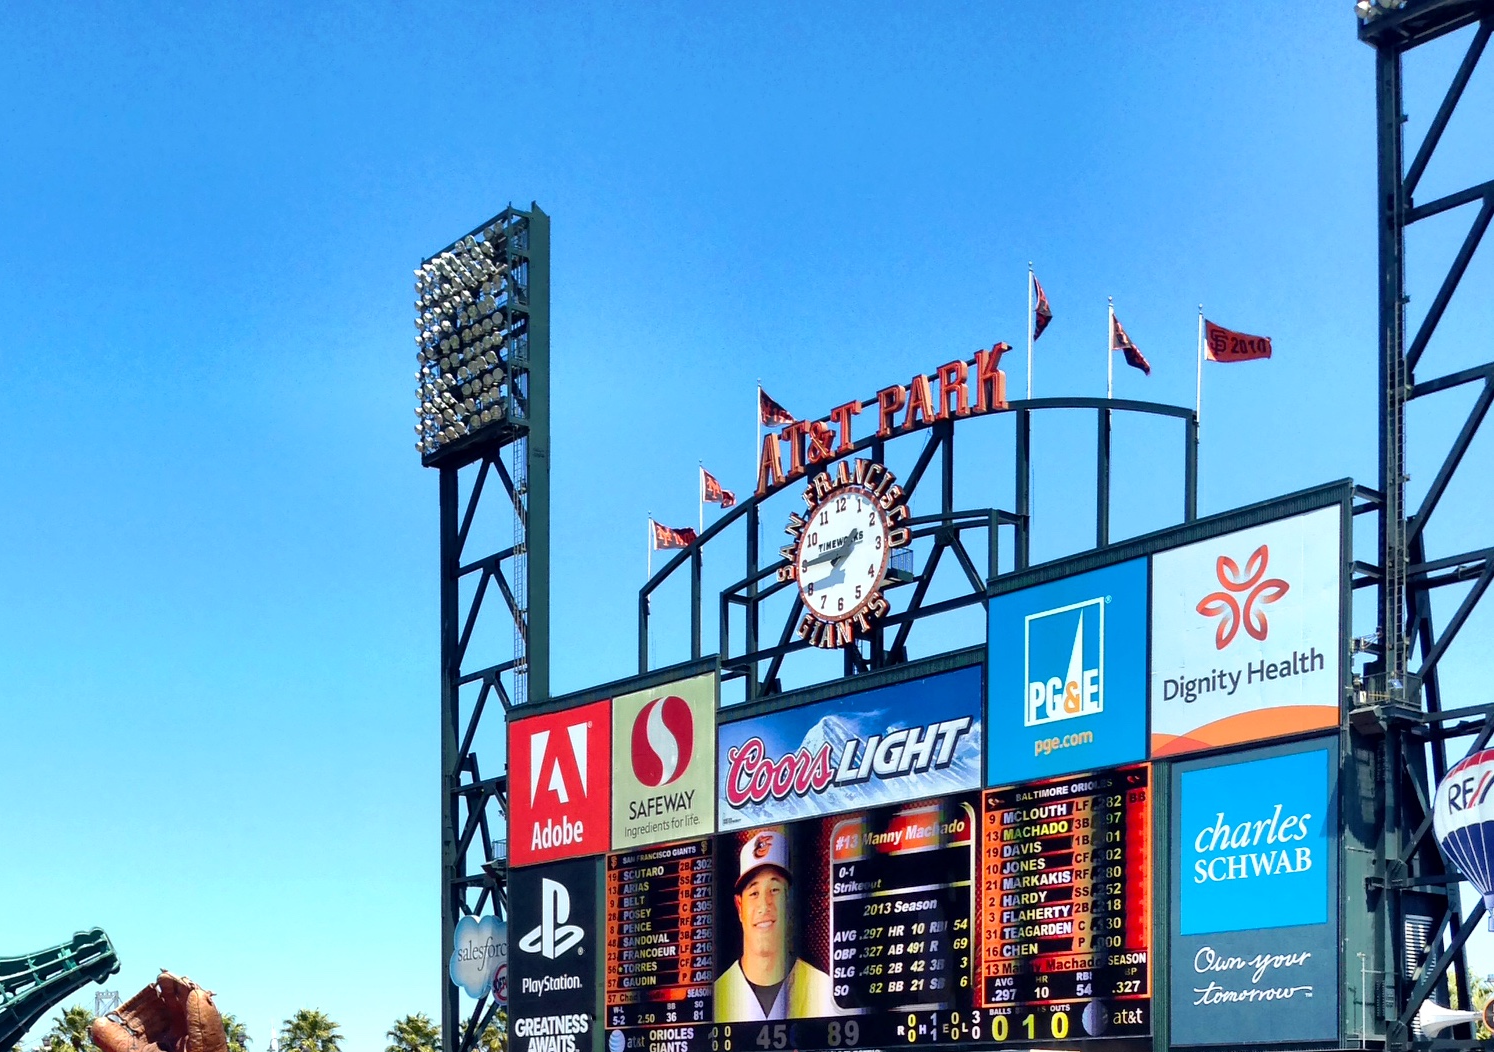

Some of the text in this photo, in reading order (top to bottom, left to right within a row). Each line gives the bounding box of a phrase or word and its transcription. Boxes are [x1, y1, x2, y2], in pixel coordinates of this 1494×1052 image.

[1230, 337, 1266, 355] 2010
[754, 341, 1012, 497] AT&T PARK
[835, 498, 847, 514] 12
[775, 457, 913, 583] SAN FRANCISCO
[819, 511, 829, 526] 11
[807, 532, 818, 548] 10
[817, 530, 865, 553] TIMEWOKS
[796, 591, 890, 650] GIANTS
[1163, 647, 1324, 704] Dignity Health
[1029, 667, 1099, 721] PG&E
[1034, 728, 1093, 757] pge.com
[725, 715, 973, 808] Coors LIGHT
[1015, 785, 1069, 802] BALTIMORE
[629, 789, 695, 821] SAFEWAY
[1003, 803, 1067, 825] MCLOUTH
[530, 815, 584, 851] Adobe
[624, 814, 701, 839] Ingredients for life.
[835, 819, 965, 851] #13 Manny Machado
[1003, 820, 1068, 841] MACHADO
[1194, 803, 1312, 853] charles
[636, 849, 672, 863] FRANCISCO
[672, 845, 697, 857] GIANTS
[1003, 841, 1042, 858] DAVIS
[623, 866, 664, 881] SCUTARO
[1003, 858, 1046, 874] JONES
[1193, 847, 1313, 884] SCHWAB
[623, 882, 650, 894] ARIAS
[833, 879, 882, 894] Strikeout
[1003, 871, 1071, 892] MARKAKIS
[623, 896, 646, 908] BELT
[863, 899, 937, 917] 2013 Season
[1003, 891, 1047, 908] HARDY
[623, 908, 652, 921] POSEY
[1003, 906, 1071, 924] FLAHERTY
[623, 922, 652, 934] PENCE
[833, 923, 925, 943] AVG .297 HR 10
[1003, 922, 1072, 941] TEAGARDEN
[623, 934, 669, 948] SANDOVAL
[1003, 942, 1038, 958] CHEN
[457, 936, 507, 971] salesforc
[623, 946, 676, 961] FRANCOEUR
[833, 945, 882, 961] OBP .327
[1108, 952, 1147, 965] SEASON
[623, 961, 657, 974] TORRES
[1193, 946, 1312, 984] Own your
[521, 973, 583, 998] PlayStation
[623, 975, 657, 988] GAUDIN
[1111, 979, 1141, 994] .327
[989, 1006, 1012, 1016] BALLS
[1049, 1003, 1071, 1013] OUTS
[1113, 1007, 1143, 1024] at&t
[515, 1013, 589, 1037] GREATNESS
[649, 1027, 694, 1041] ORIOLES
[827, 1019, 860, 1047] 89
[991, 1015, 1009, 1041] 0
[1022, 1014, 1036, 1040] 1
[1051, 1012, 1069, 1039] 0
[756, 1023, 787, 1050] 45
